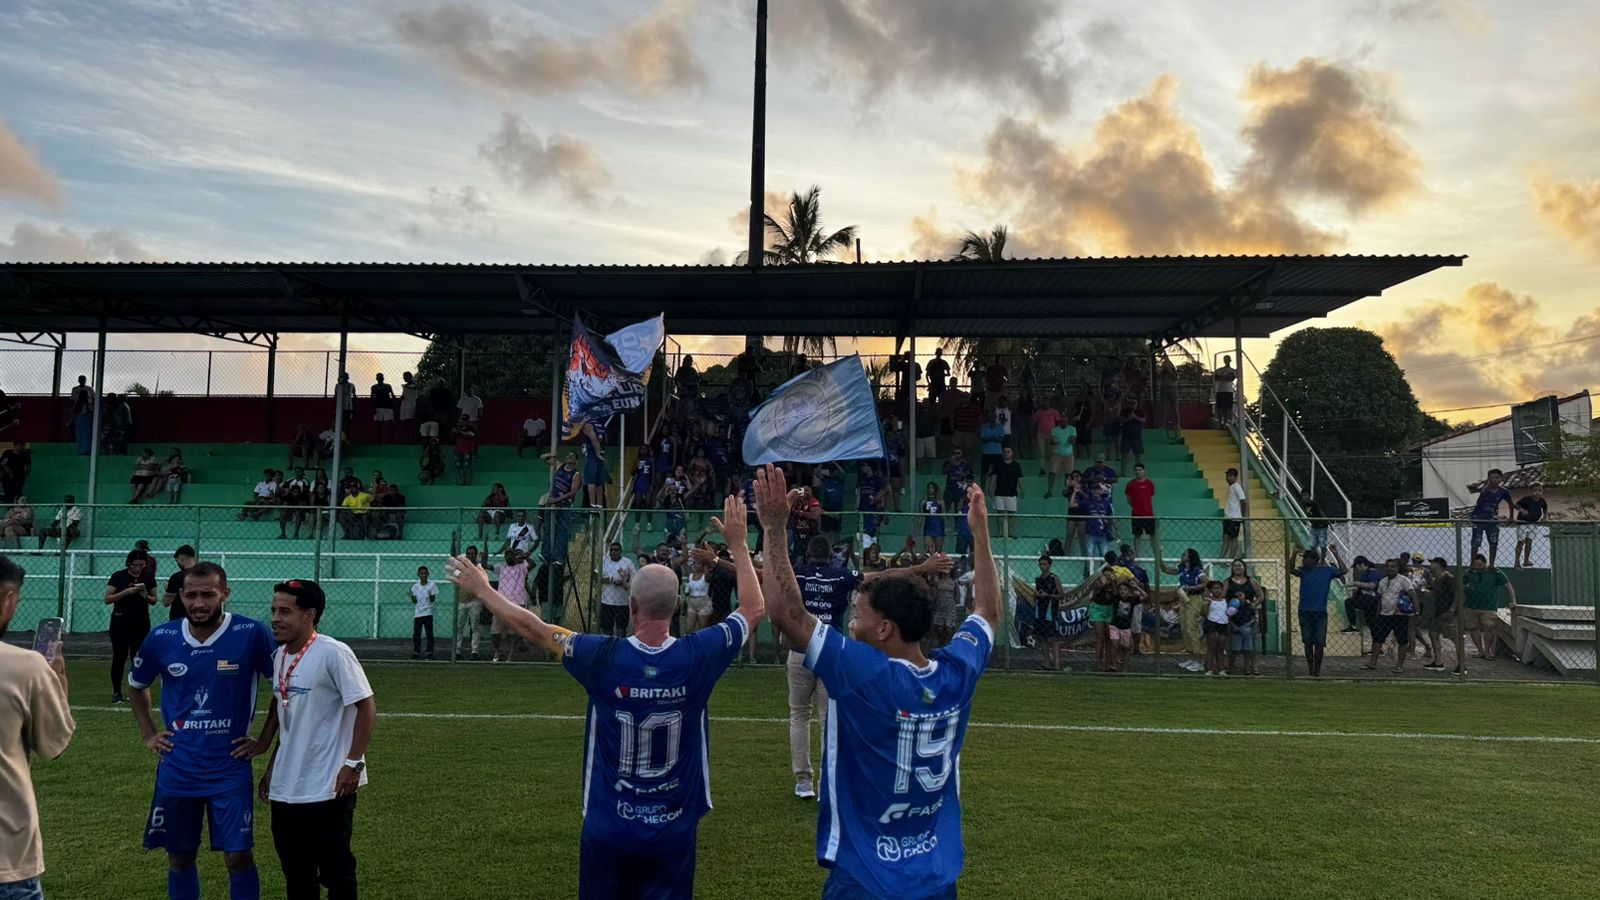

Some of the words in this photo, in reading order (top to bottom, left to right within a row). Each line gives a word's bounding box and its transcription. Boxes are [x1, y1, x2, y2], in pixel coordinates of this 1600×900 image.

[629, 685, 686, 699] BRITAKI
[182, 718, 231, 730] BRITAKI
[615, 710, 682, 778] 10
[893, 710, 960, 793] 19
[152, 806, 164, 827] 6
[635, 805, 667, 815] GRUPO
